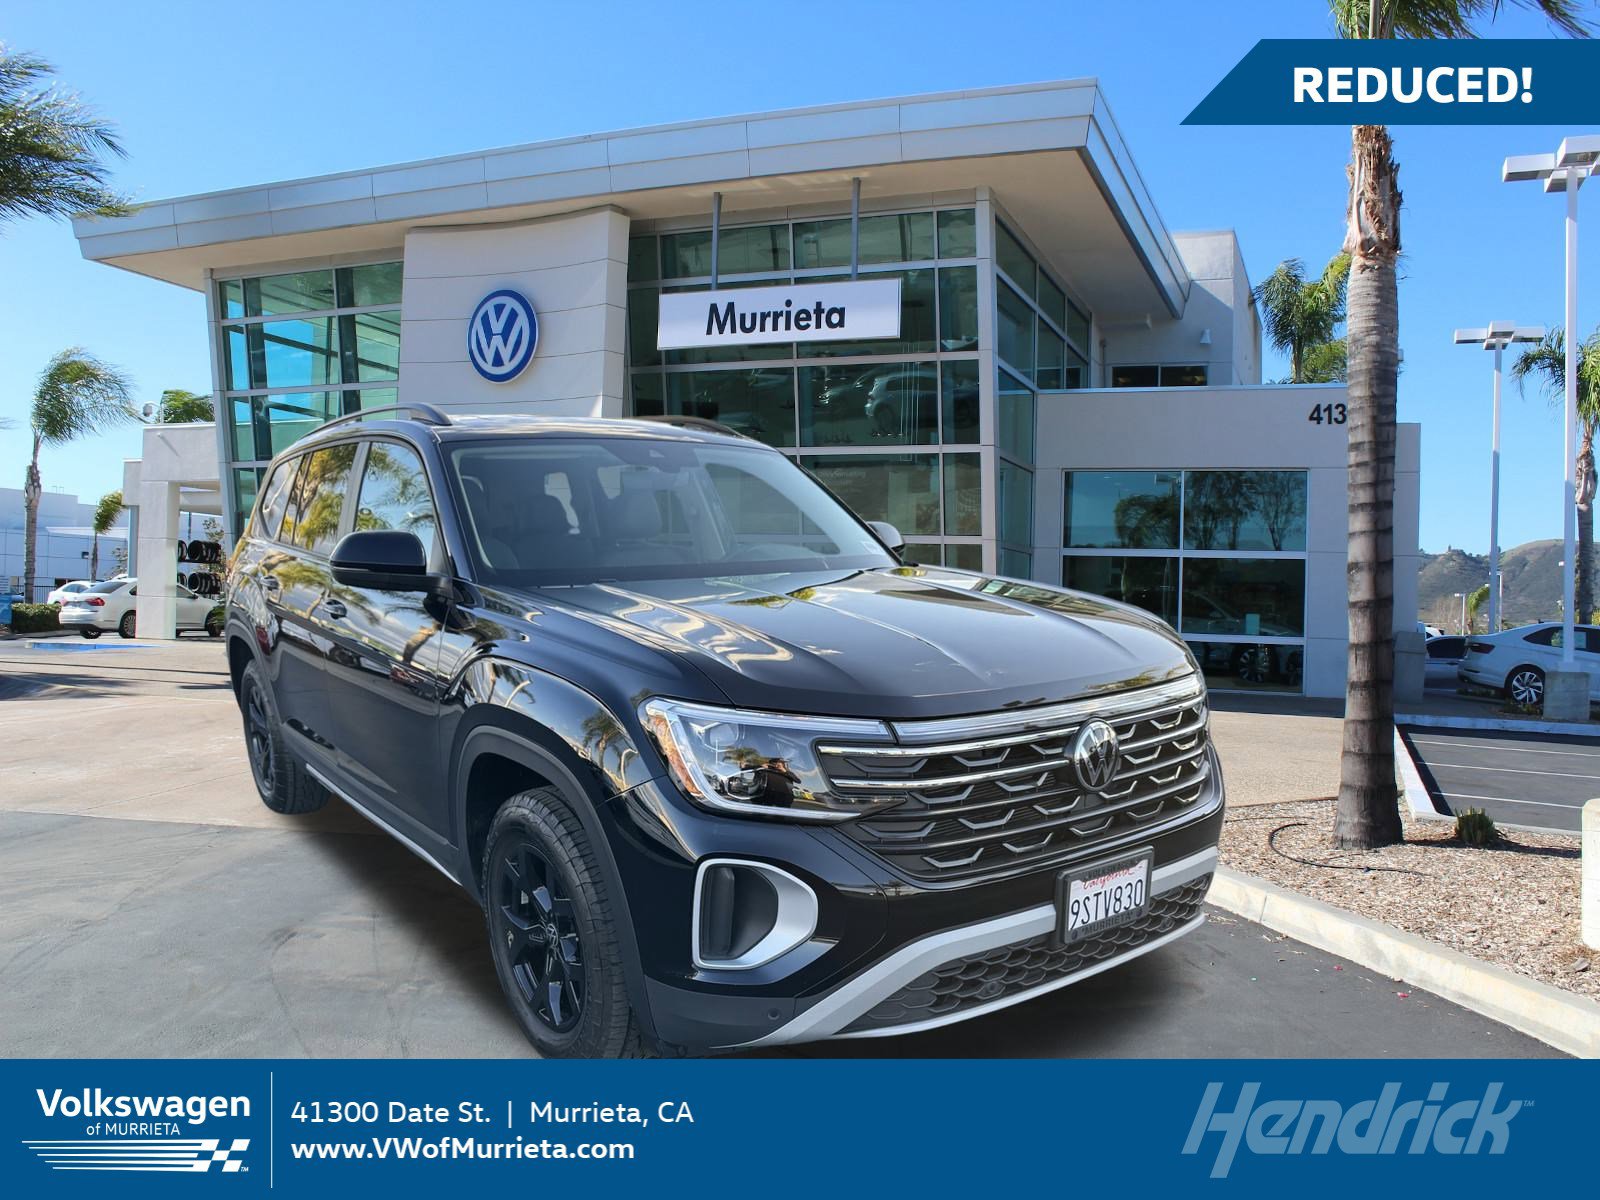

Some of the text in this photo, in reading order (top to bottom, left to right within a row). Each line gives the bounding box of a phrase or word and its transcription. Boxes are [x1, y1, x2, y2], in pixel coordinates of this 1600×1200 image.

[706, 299, 846, 335] Murrieta
[1308, 403, 1347, 425] 413
[1070, 878, 1144, 930] 9STV830
